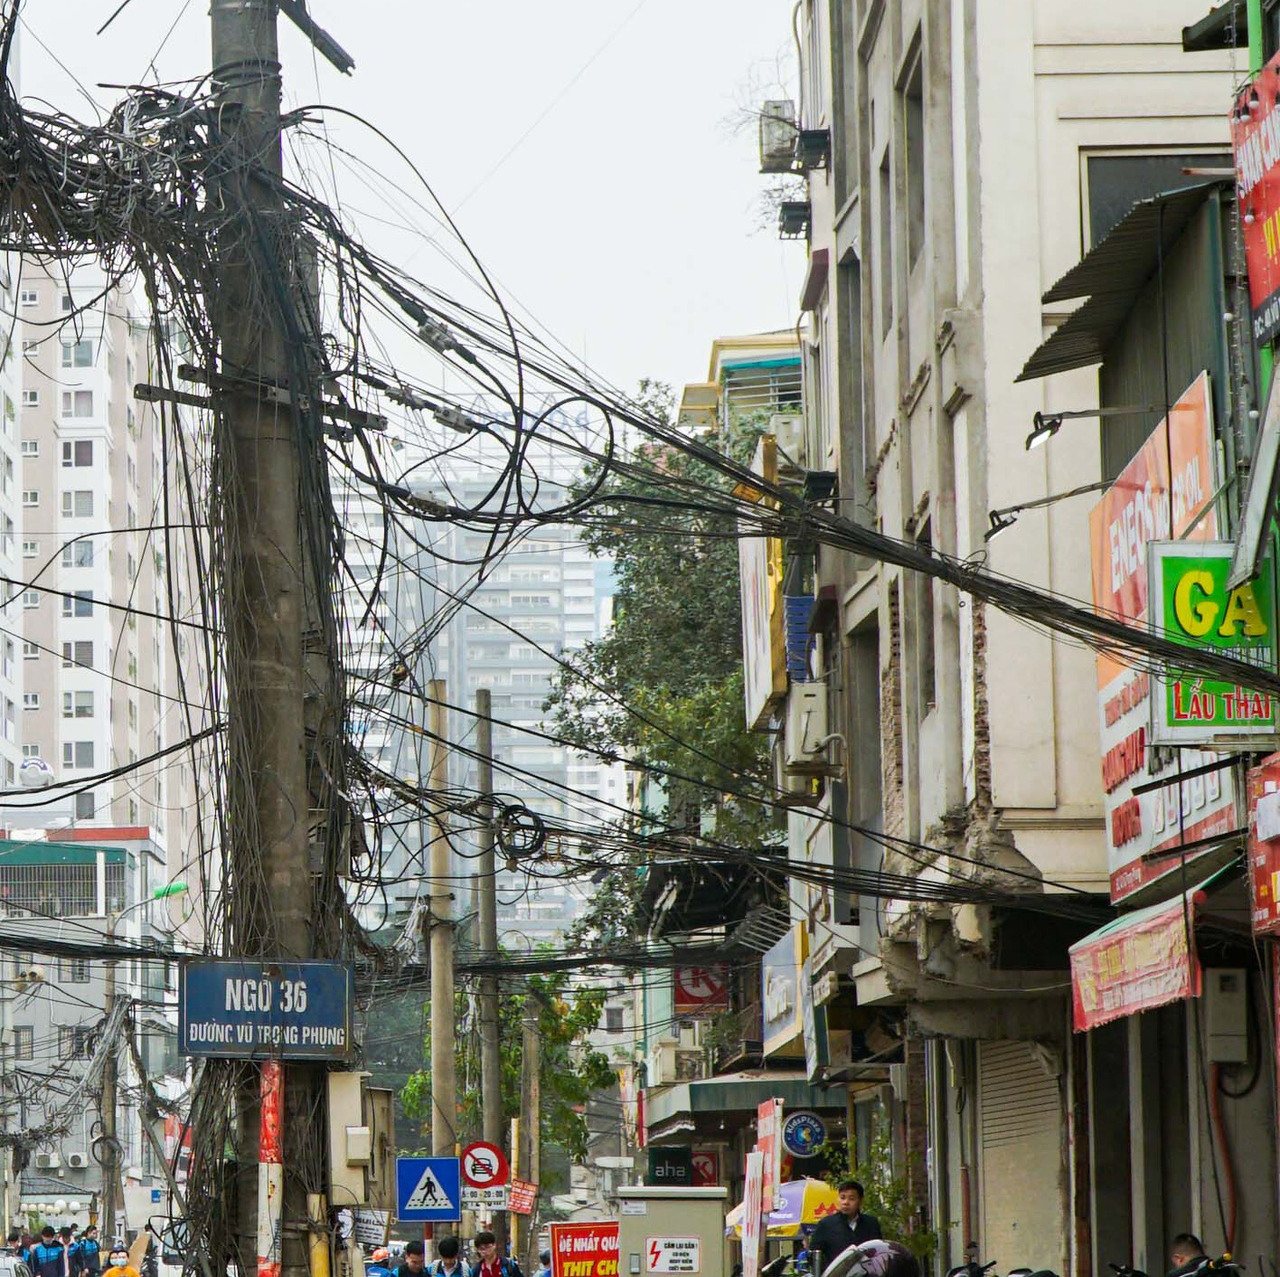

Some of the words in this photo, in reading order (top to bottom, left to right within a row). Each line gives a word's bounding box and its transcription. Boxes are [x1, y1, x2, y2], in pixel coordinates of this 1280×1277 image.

[280, 980, 307, 1013] 36
[302, 1026, 345, 1049] PHỤNG
[655, 1160, 686, 1177] aha
[597, 1260, 619, 1277] CH
